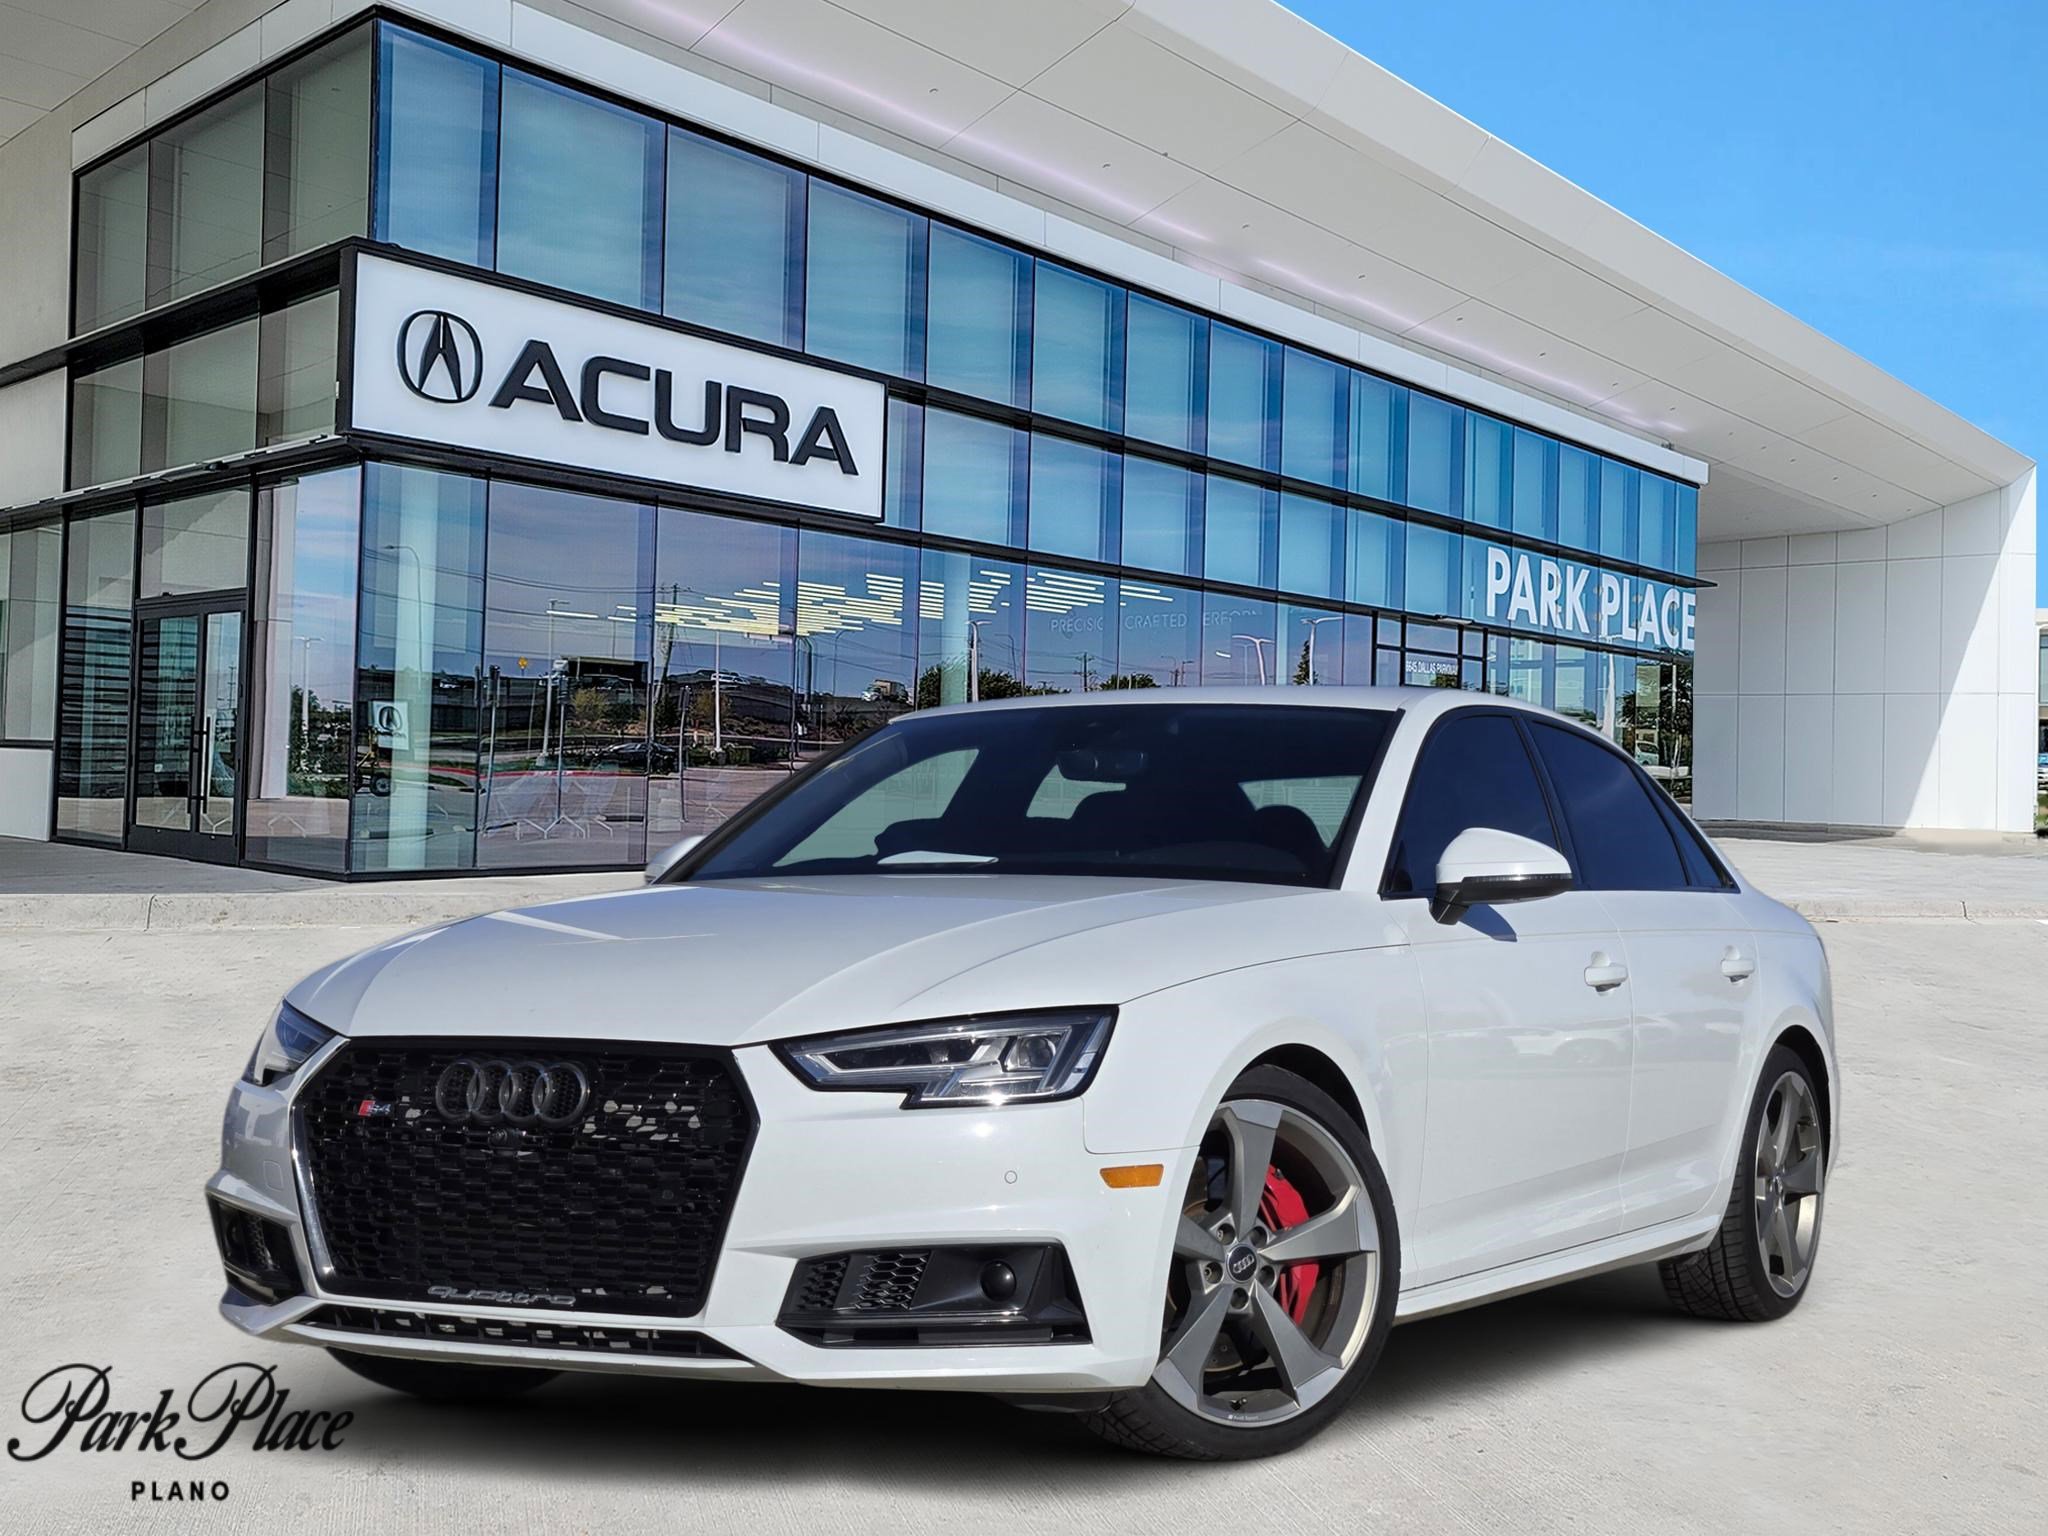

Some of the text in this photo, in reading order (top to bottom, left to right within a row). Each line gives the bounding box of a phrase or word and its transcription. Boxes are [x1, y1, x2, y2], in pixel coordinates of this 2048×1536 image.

[489, 339, 859, 476] ACURA
[1124, 613, 1187, 629] CRAFTED
[1486, 546, 1696, 650] PARK PLACE
[428, 1286, 577, 1306] quattro
